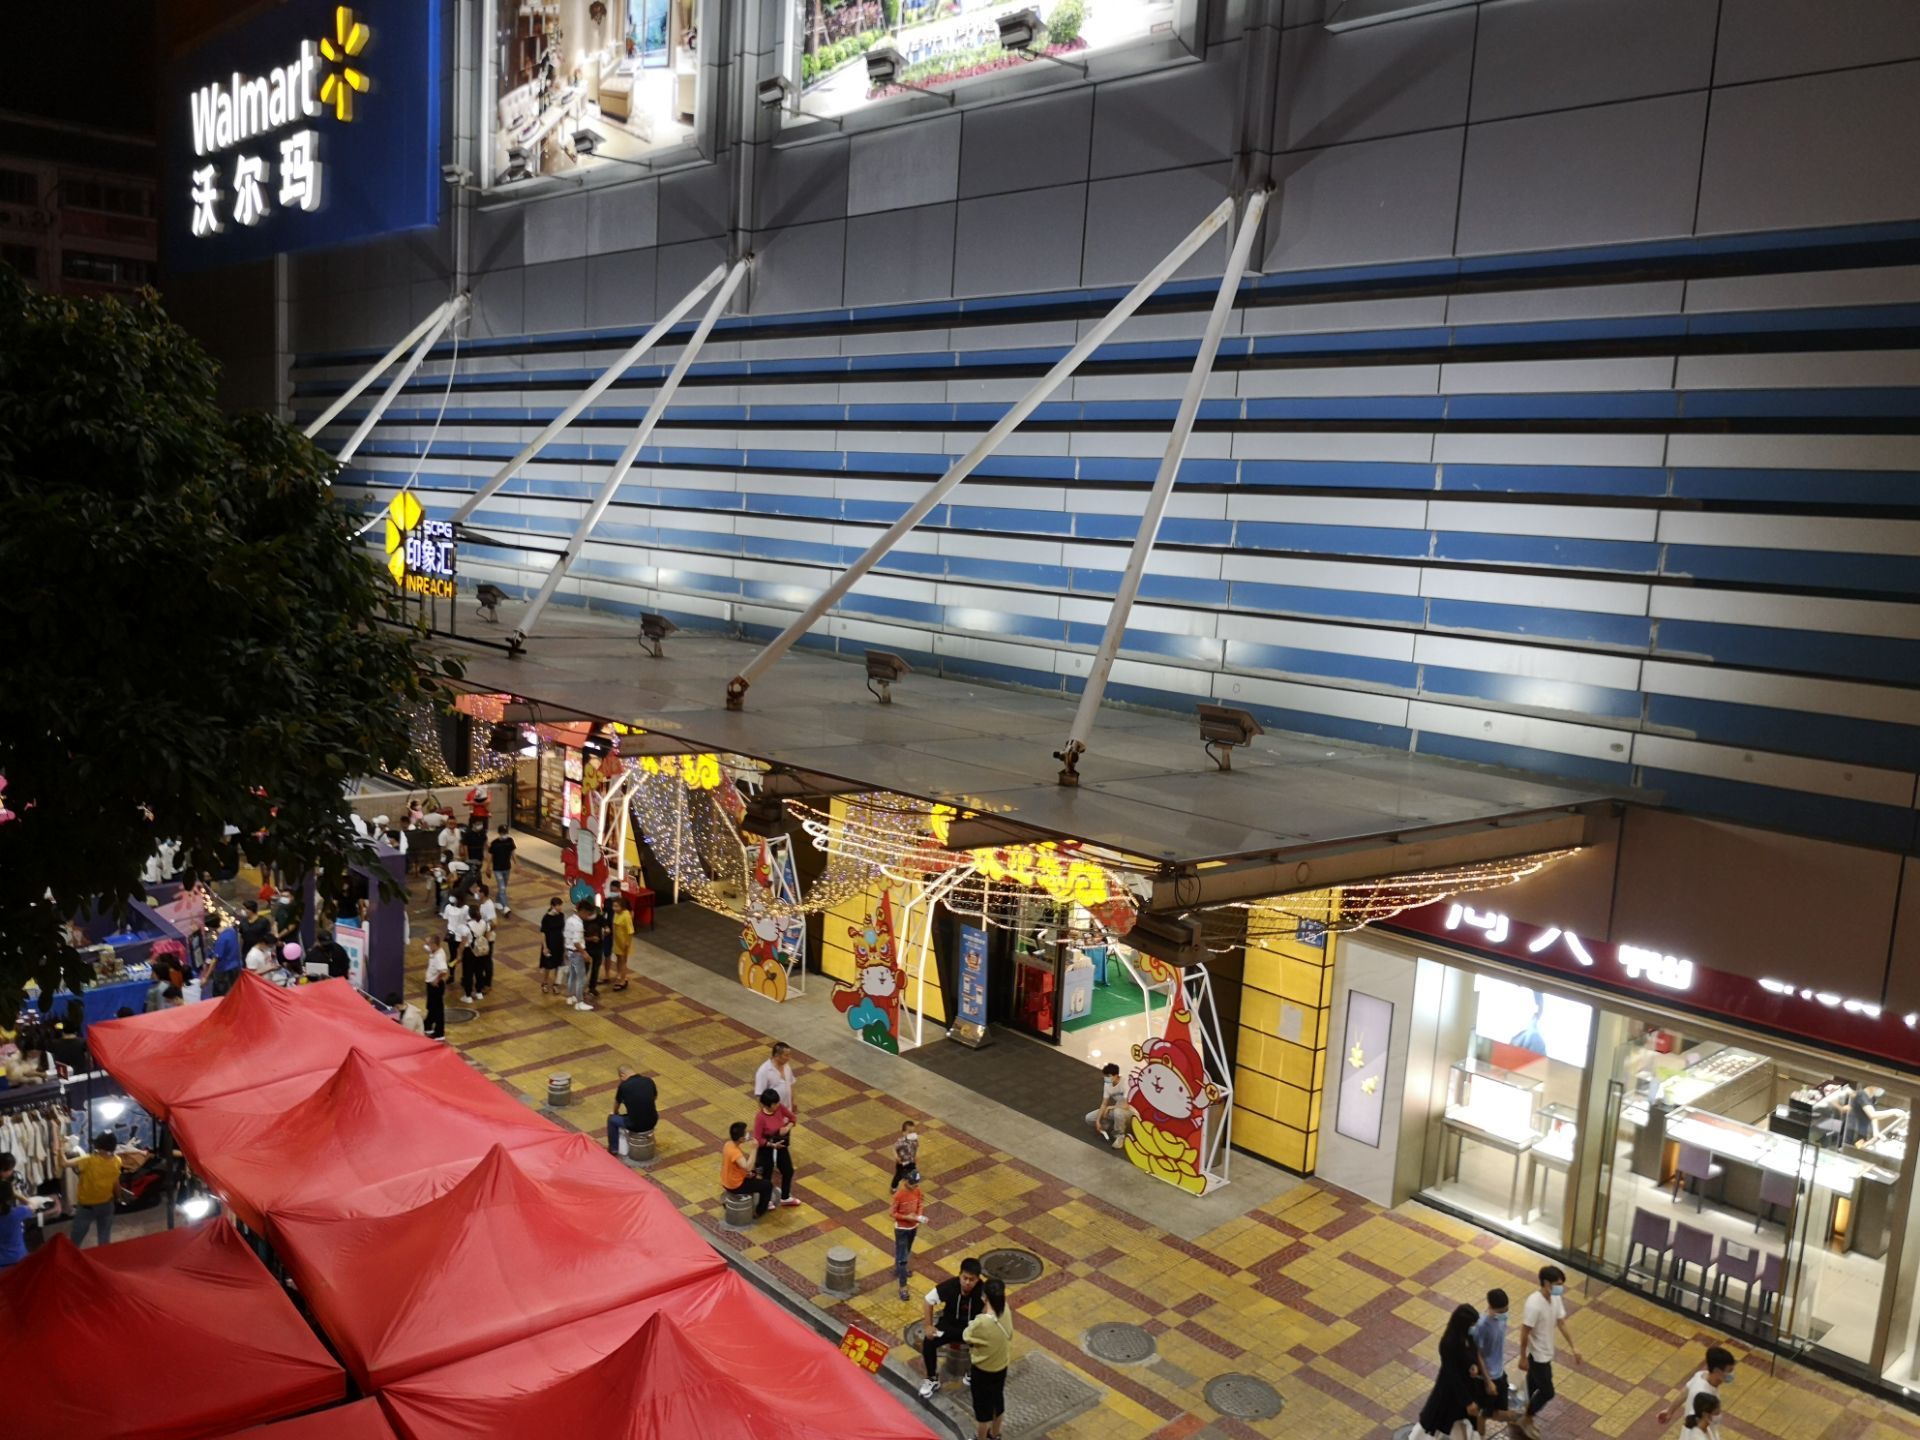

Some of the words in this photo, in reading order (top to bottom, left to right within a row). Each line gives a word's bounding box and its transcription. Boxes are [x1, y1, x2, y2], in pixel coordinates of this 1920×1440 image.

[191, 38, 320, 157] Walmart
[191, 129, 321, 237] 沃尔玛
[423, 519, 453, 538] SCPG
[406, 537, 454, 575] 印象汇
[406, 574, 453, 598] INREACH
